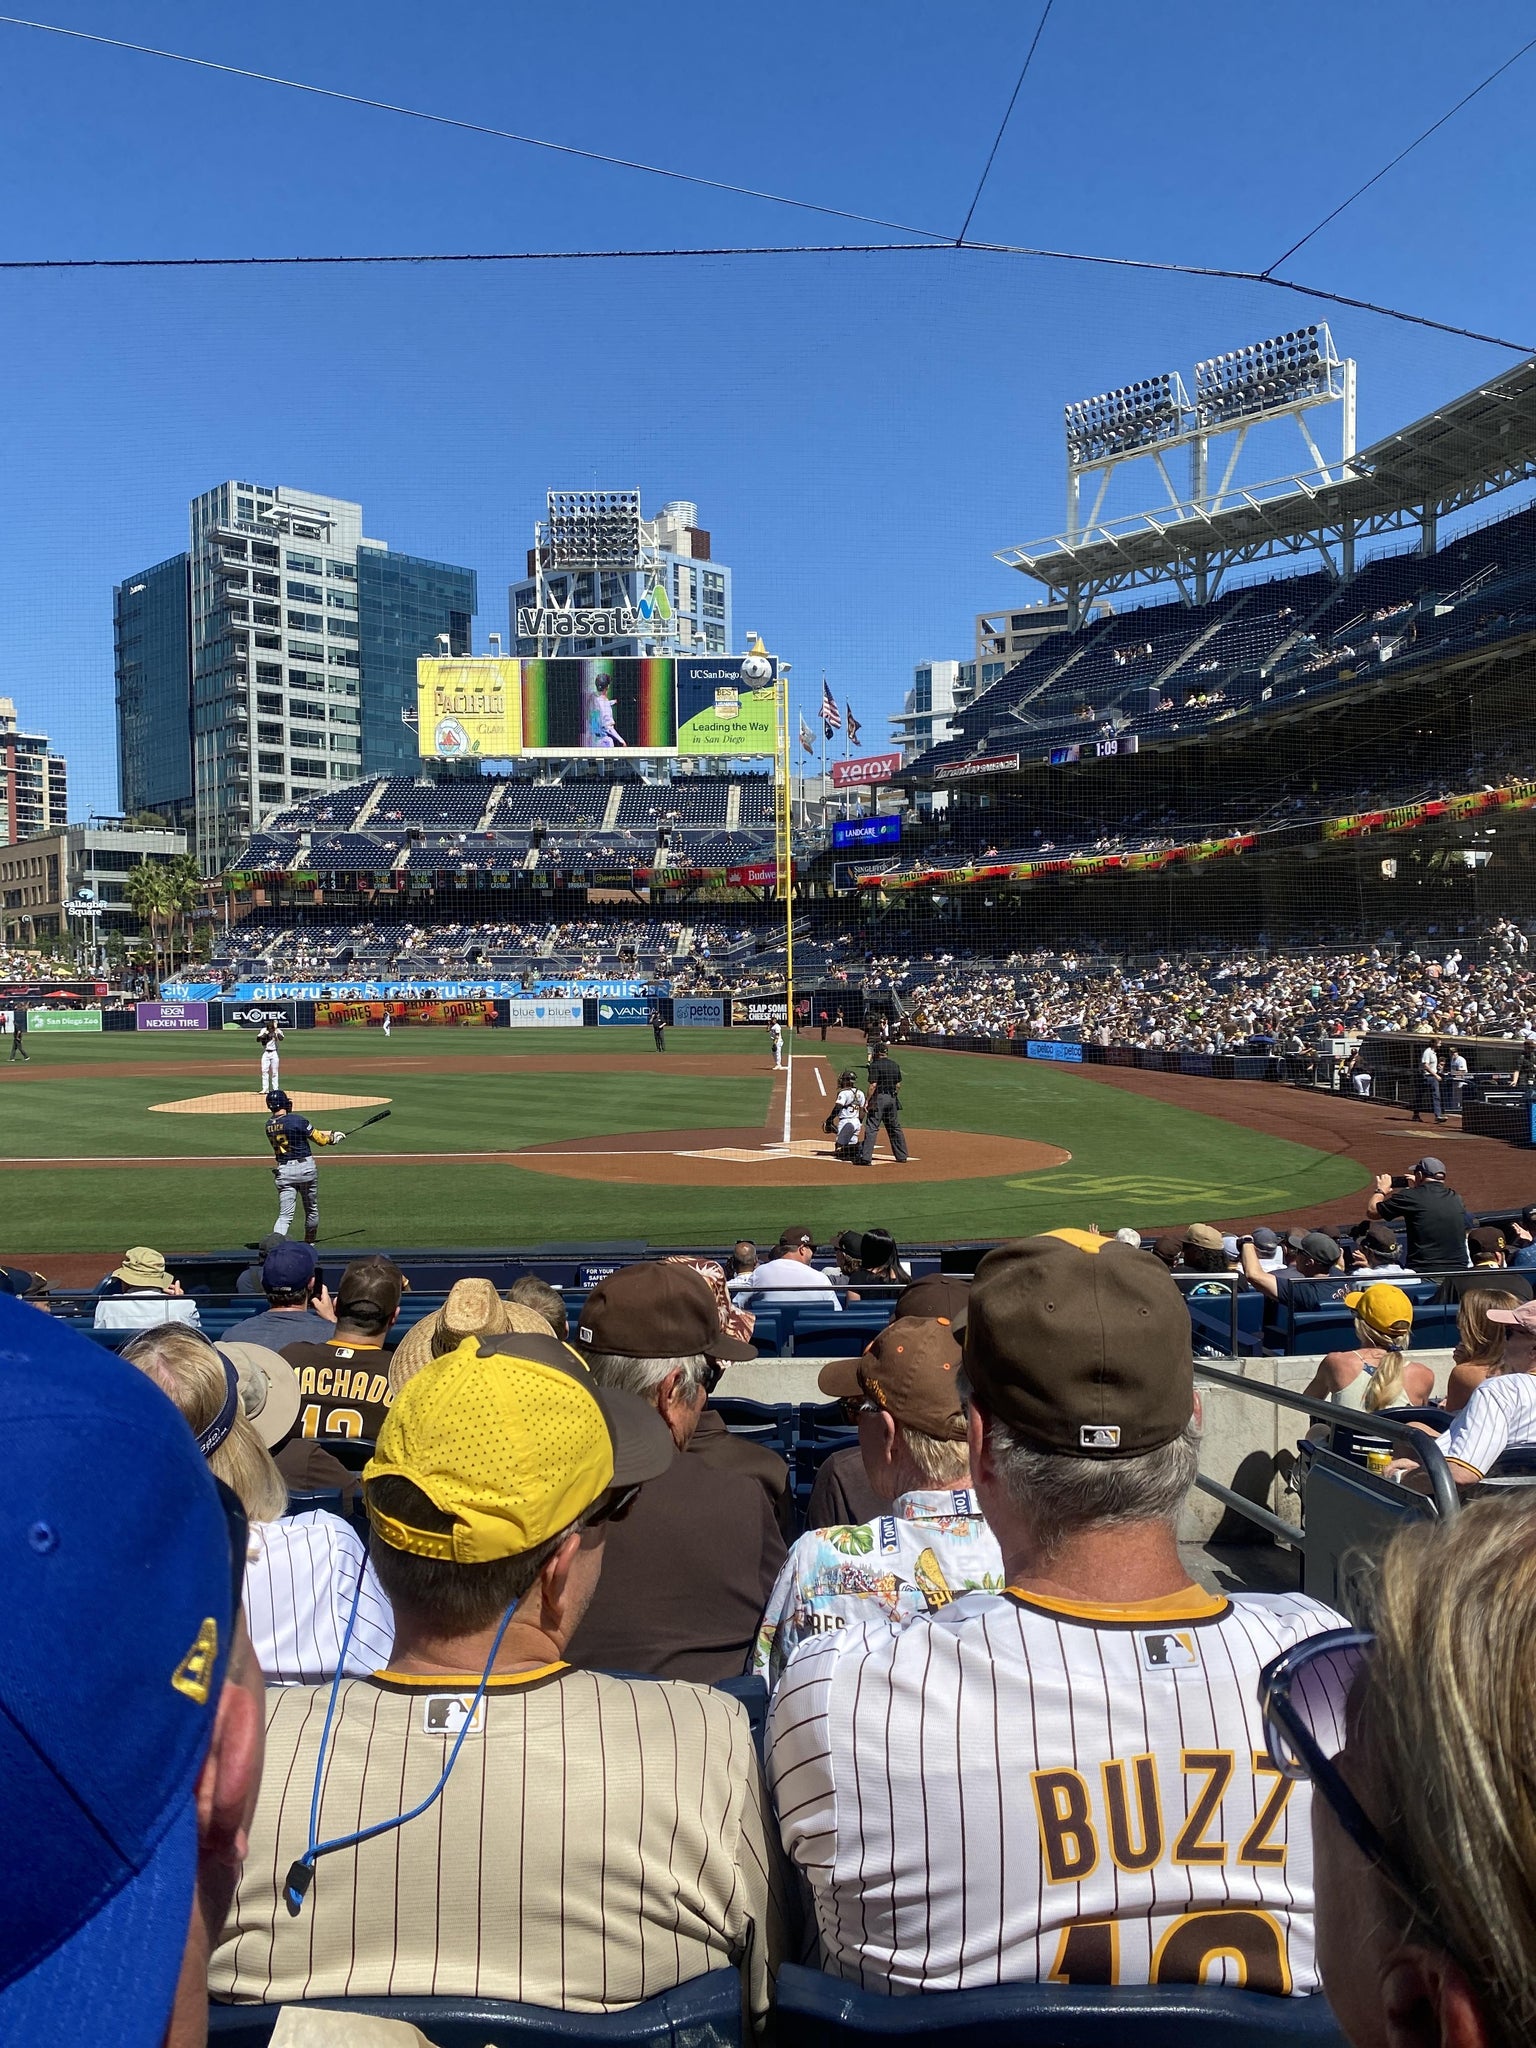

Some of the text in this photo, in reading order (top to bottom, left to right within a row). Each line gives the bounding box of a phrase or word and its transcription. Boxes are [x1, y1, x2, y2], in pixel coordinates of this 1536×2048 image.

[521, 607, 628, 636] Viasat
[690, 669, 740, 681] UC San Diego
[716, 688, 736, 696] BEST
[692, 723, 769, 733] Leading the Way
[722, 735, 745, 745] Diego
[1096, 740, 1118, 757] 1:09
[839, 759, 893, 784] xerox
[845, 826, 877, 837] LANDCARE
[62, 900, 108, 910] Gallagher
[68, 907, 102, 917] Square
[165, 984, 190, 998] city
[253, 983, 360, 1000] citycruses
[328, 1005, 371, 1025] PADRES
[444, 1001, 486, 1019] PADRES
[511, 1007, 571, 1017] blue blue
[690, 1004, 720, 1018] petco
[749, 1004, 767, 1012] SLAP
[46, 1017, 99, 1026] San Diego Zoo
[233, 1008, 287, 1023] EVOTEK
[146, 1019, 200, 1028] NEXEN TIRE
[294, 1366, 395, 1408] ACHAD
[953, 1490, 969, 1514] TON
[1029, 1750, 1297, 1885] BUZZ
